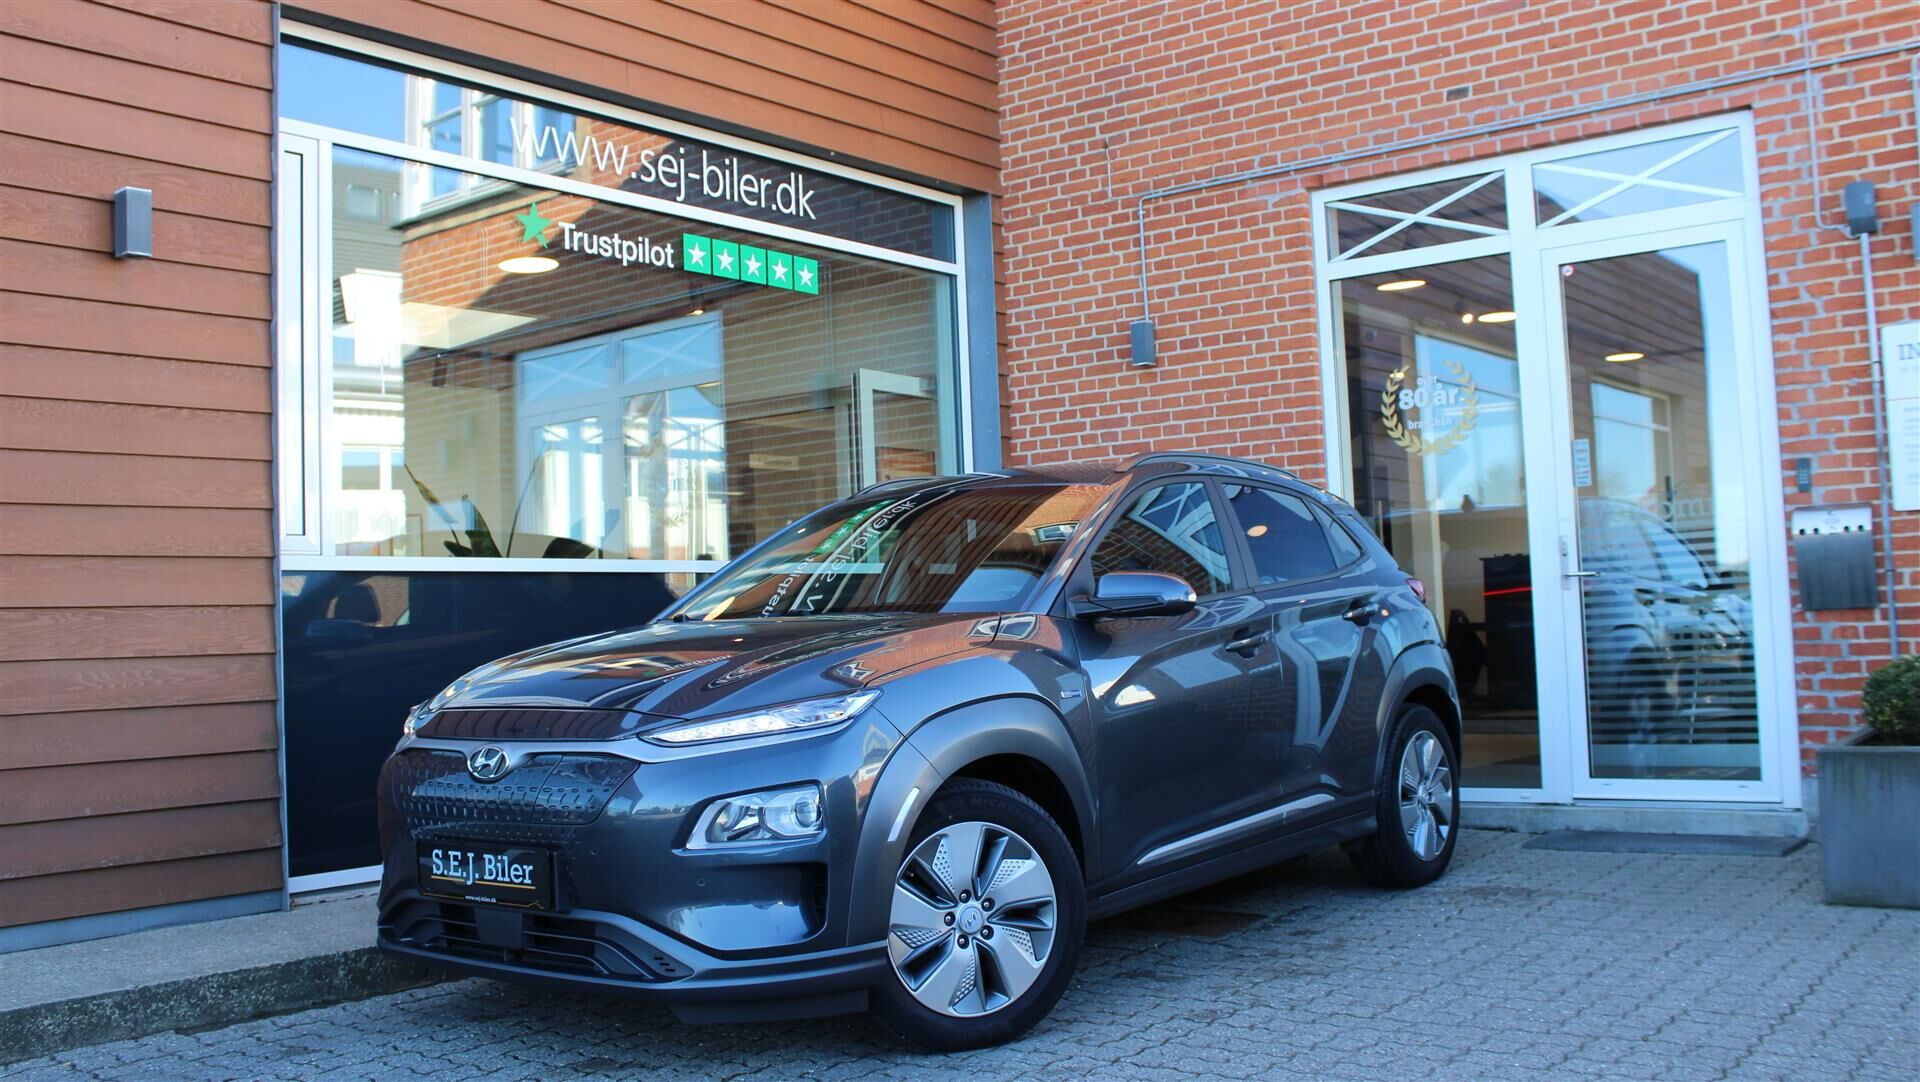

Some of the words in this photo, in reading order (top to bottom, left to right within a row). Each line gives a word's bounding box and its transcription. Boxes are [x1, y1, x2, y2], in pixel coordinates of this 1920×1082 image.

[510, 117, 816, 219] www.sej-biler.dk
[558, 221, 675, 269] Trustpilot
[1399, 386, 1428, 410] 80
[432, 849, 479, 885] S.E.J.
[483, 854, 533, 884] Biler
